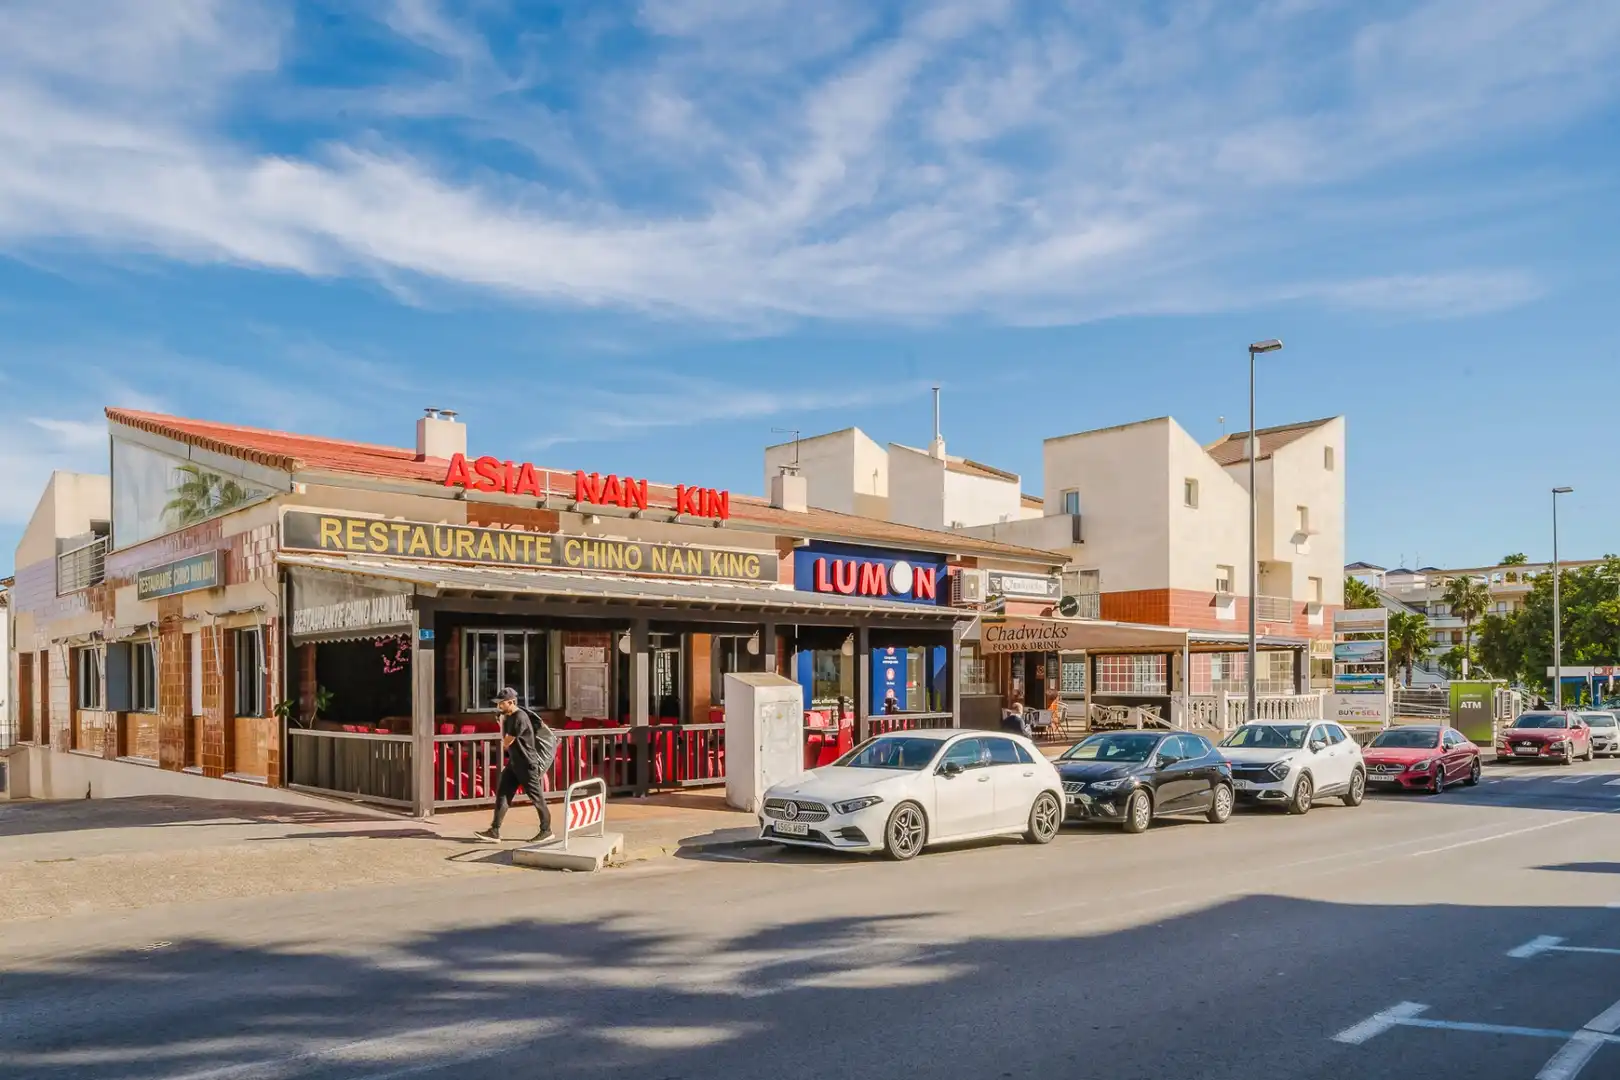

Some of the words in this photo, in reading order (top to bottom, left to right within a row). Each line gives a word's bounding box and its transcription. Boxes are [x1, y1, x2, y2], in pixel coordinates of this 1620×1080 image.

[444, 452, 541, 497] ASIA
[575, 469, 648, 510] NAN
[677, 483, 729, 521] KIN
[320, 517, 552, 564] RESTAURANTE
[564, 539, 642, 570] CHINO
[652, 547, 702, 575] NAN
[710, 551, 760, 578] KING
[815, 557, 936, 599] LUMON
[293, 605, 345, 633] RESTAURANTE
[345, 600, 370, 627] CHINO
[372, 597, 391, 623] NAN
[986, 623, 1069, 642] Chadwicks
[993, 643, 1018, 651] FOOD
[1030, 640, 1061, 650] DRINK
[1460, 701, 1482, 709] ATM
